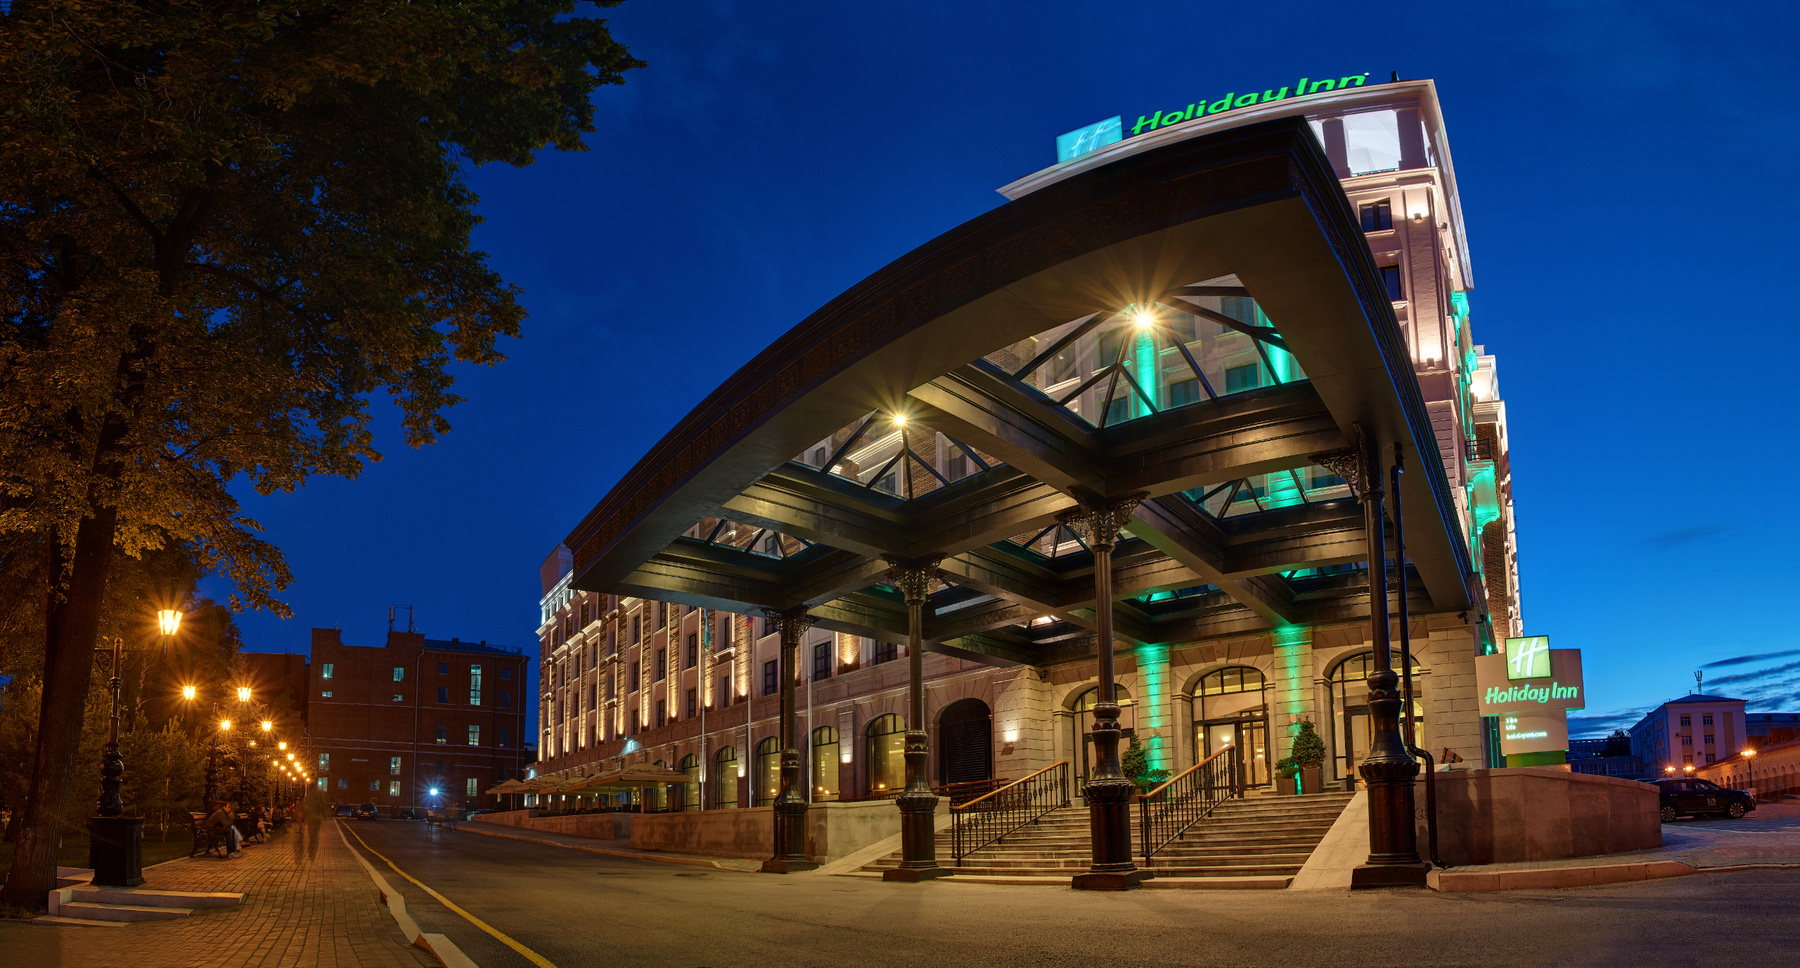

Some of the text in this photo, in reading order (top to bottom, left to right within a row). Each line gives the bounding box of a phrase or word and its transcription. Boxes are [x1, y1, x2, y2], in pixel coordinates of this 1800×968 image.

[1131, 74, 1367, 135] Holiday Inn
[1484, 681, 1578, 705] Holiday Inn
